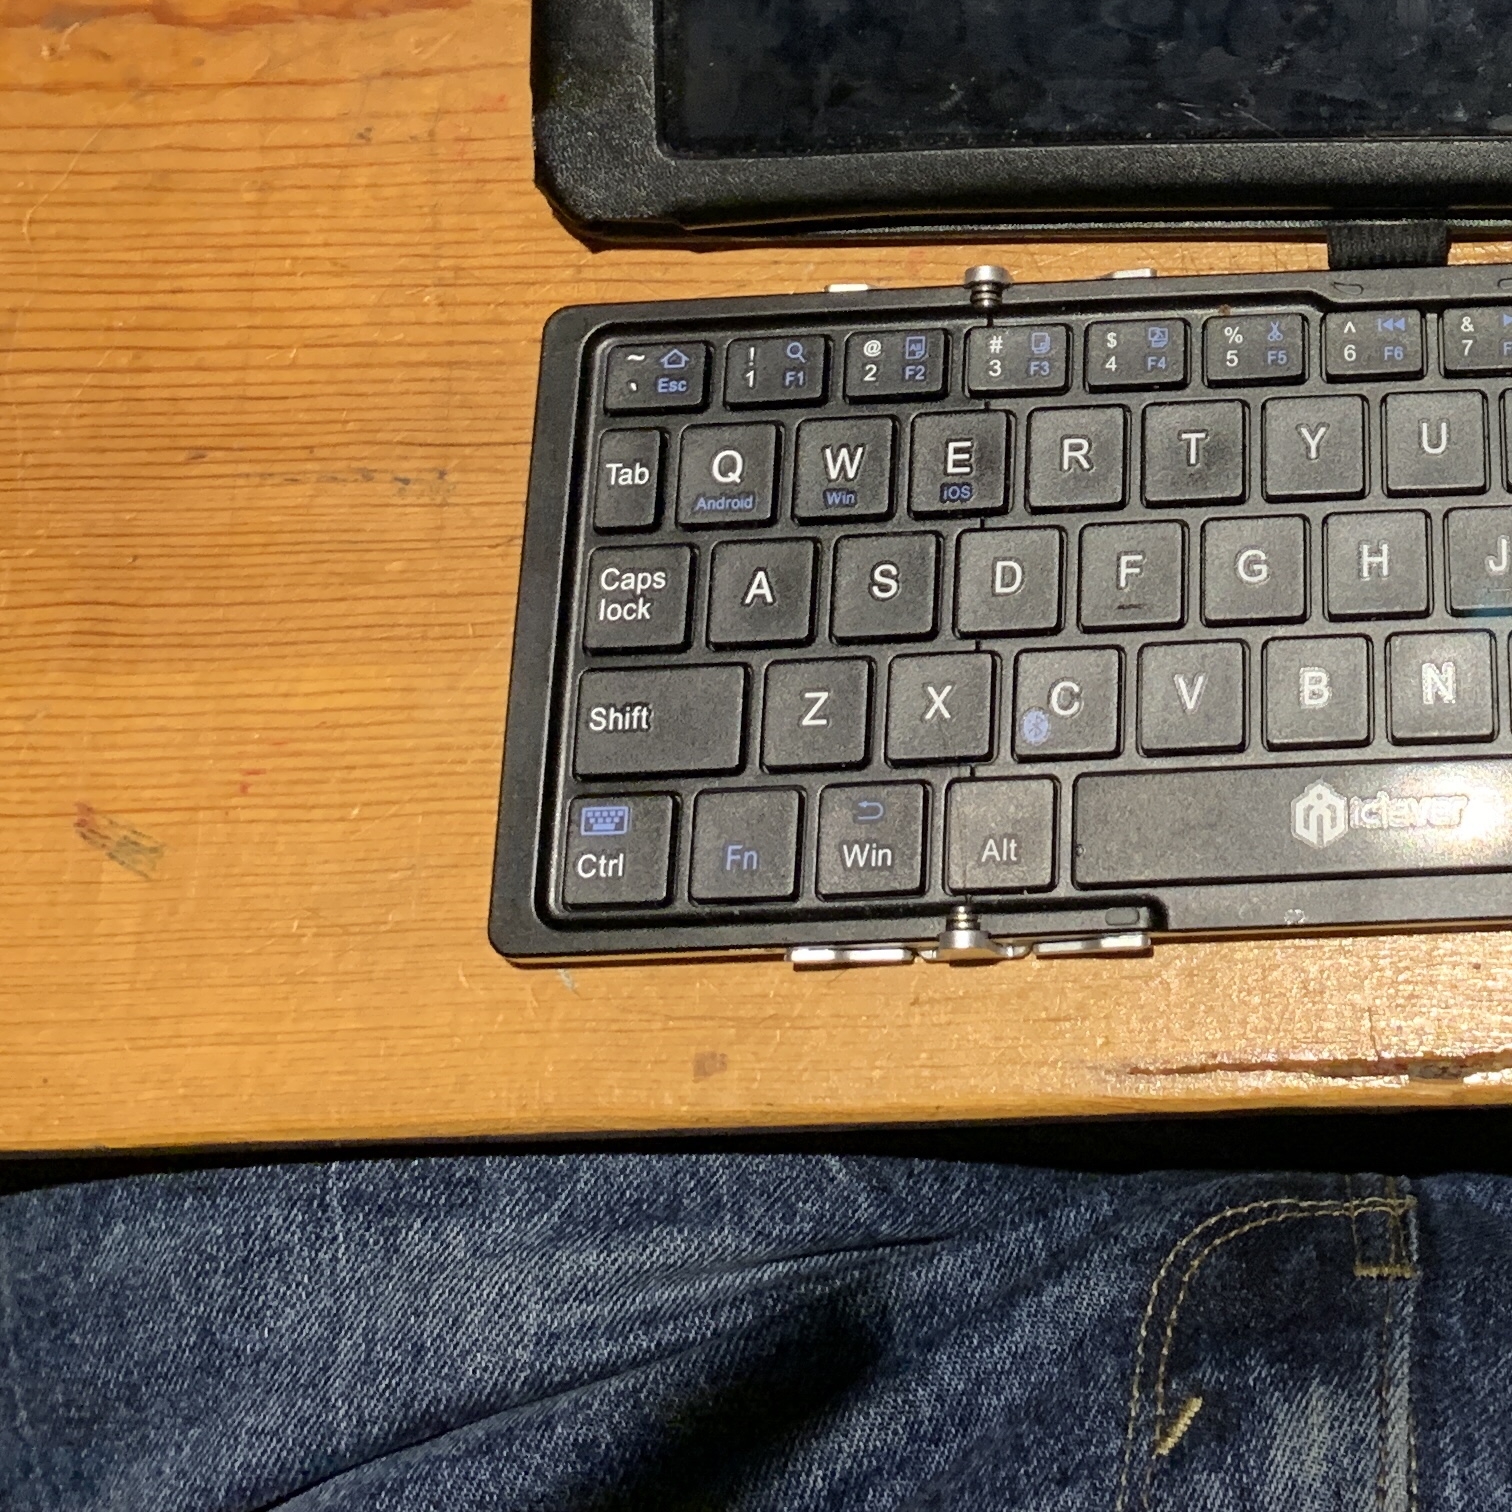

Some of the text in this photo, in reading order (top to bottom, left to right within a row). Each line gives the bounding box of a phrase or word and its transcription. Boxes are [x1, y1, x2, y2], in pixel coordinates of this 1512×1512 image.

[1225, 327, 1243, 343] %
[1461, 317, 1474, 332] &
[863, 340, 881, 357] @
[989, 337, 1003, 353] #
[1107, 332, 1117, 348] $
[1462, 340, 1473, 356] 7
[1106, 356, 1117, 372] 4
[1148, 357, 1167, 370] F4
[1226, 350, 1238, 367] 5
[1268, 351, 1287, 365] F5
[1344, 346, 1356, 361] 6
[1384, 347, 1404, 360] F6
[746, 372, 754, 387] 1
[785, 372, 805, 386] F1
[865, 365, 877, 381] 2
[905, 365, 925, 380] F2
[989, 360, 1001, 376] 3
[1030, 362, 1050, 375] F3
[658, 378, 687, 392] Esc
[1182, 433, 1206, 465] T
[1301, 427, 1326, 459] Y
[1422, 422, 1447, 454] U
[824, 447, 863, 479] W
[947, 442, 972, 473] E
[1063, 439, 1090, 470] R
[606, 464, 649, 485] Tab
[712, 450, 744, 483] Q
[696, 496, 753, 511] Android
[827, 491, 855, 504] Win
[943, 486, 971, 500] iOS
[1361, 544, 1389, 578] H
[1487, 536, 1507, 571] J
[995, 561, 1022, 594] D
[1119, 555, 1143, 588] F
[1238, 550, 1267, 582] G
[601, 569, 666, 594] Caps
[745, 571, 773, 604] A
[872, 565, 898, 598] S
[600, 598, 650, 620] lock
[1174, 674, 1205, 710] V
[1300, 669, 1331, 706] B
[1422, 662, 1456, 704] N
[802, 692, 828, 726] Z
[925, 686, 952, 719] X
[1051, 681, 1080, 715] C
[590, 706, 649, 731] Shift
[726, 845, 757, 870] Fn
[843, 844, 891, 868] Win
[982, 839, 1017, 862] Alt
[578, 854, 624, 878] Ctrl
